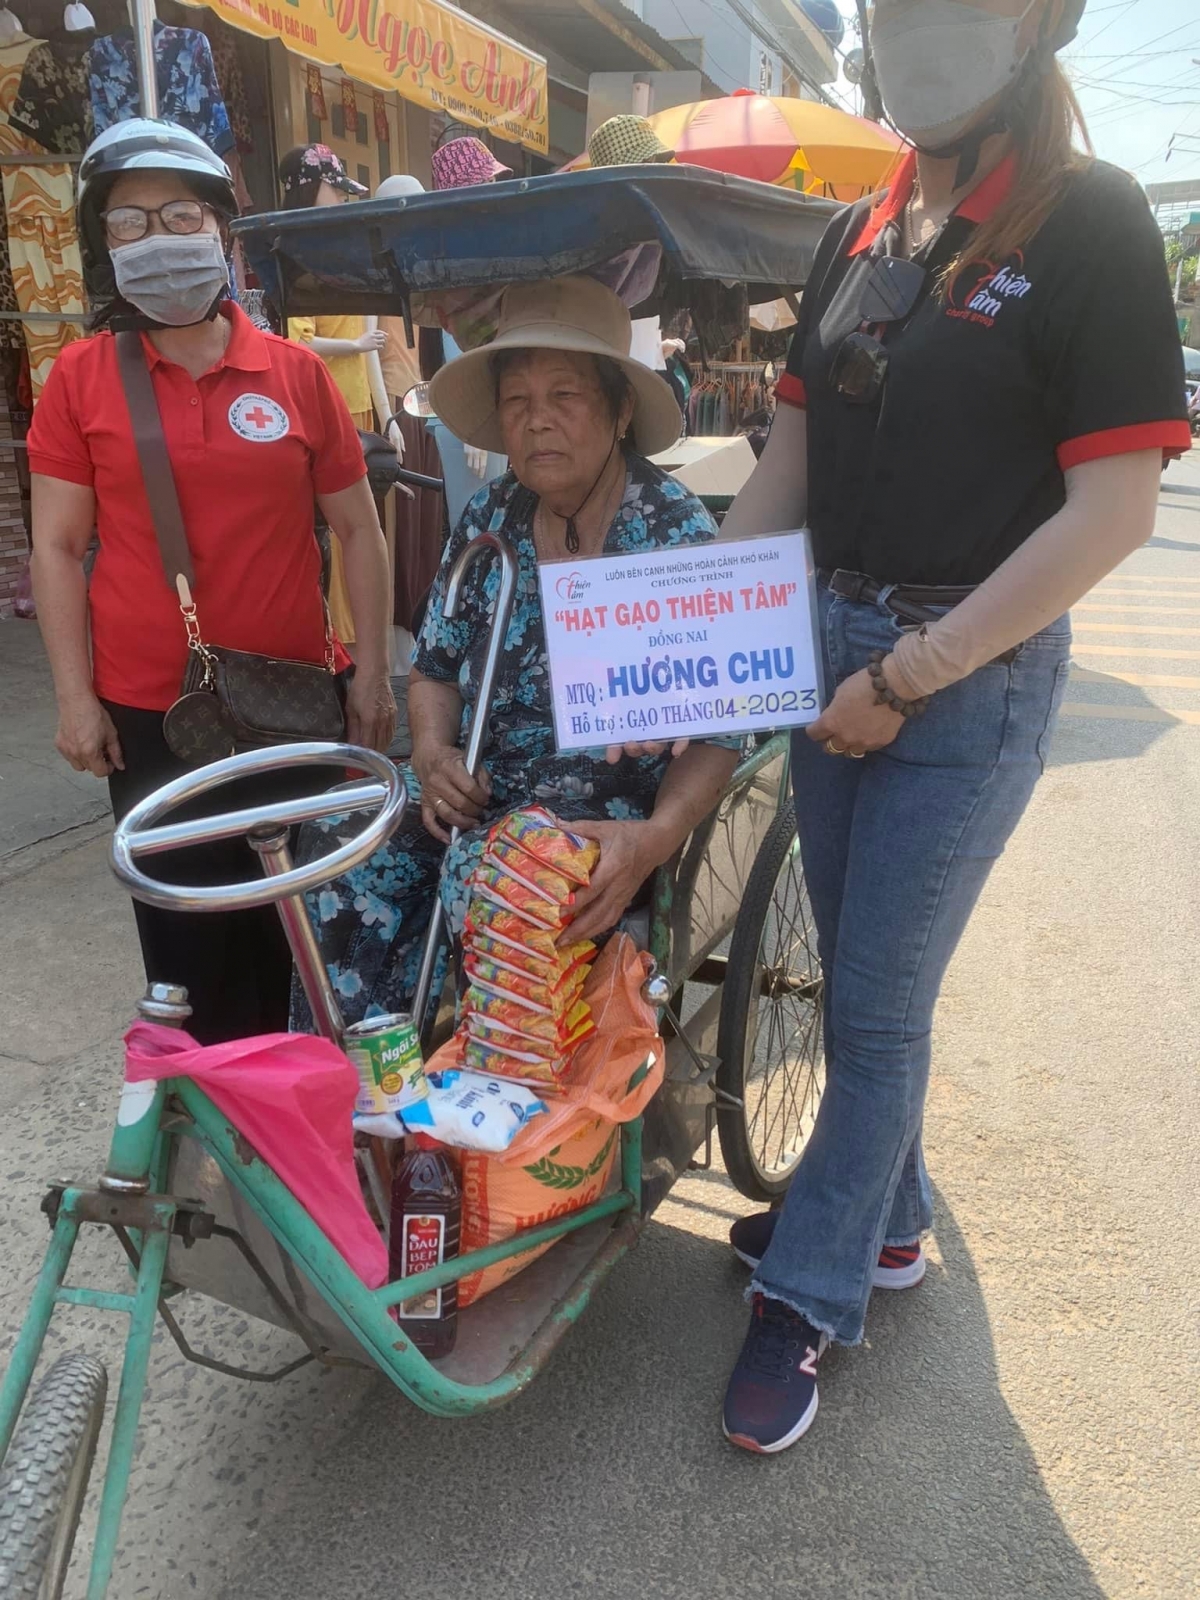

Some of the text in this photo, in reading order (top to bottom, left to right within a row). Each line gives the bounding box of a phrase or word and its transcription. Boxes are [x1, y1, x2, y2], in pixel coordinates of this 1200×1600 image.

[461, 41, 544, 120] Anh
[604, 567, 626, 582] LUÔN
[626, 565, 643, 579] BÊN
[665, 559, 693, 575] NHỮNG
[694, 557, 716, 571] HOÀN
[717, 555, 739, 569] CẢNH
[740, 553, 757, 566] KHÓ
[650, 569, 734, 589] CHƯƠNG TRÌNH
[614, 599, 661, 632] GẠO
[666, 588, 734, 623] THIỆN
[647, 629, 709, 648] ĐỒNG NAI
[606, 654, 719, 699] HƯƠNG
[727, 646, 795, 685] CHU
[571, 711, 591, 735] Hỗ
[626, 705, 659, 731] GẠO
[380, 1037, 409, 1064] Ngôi
[799, 1345, 818, 1376] N
